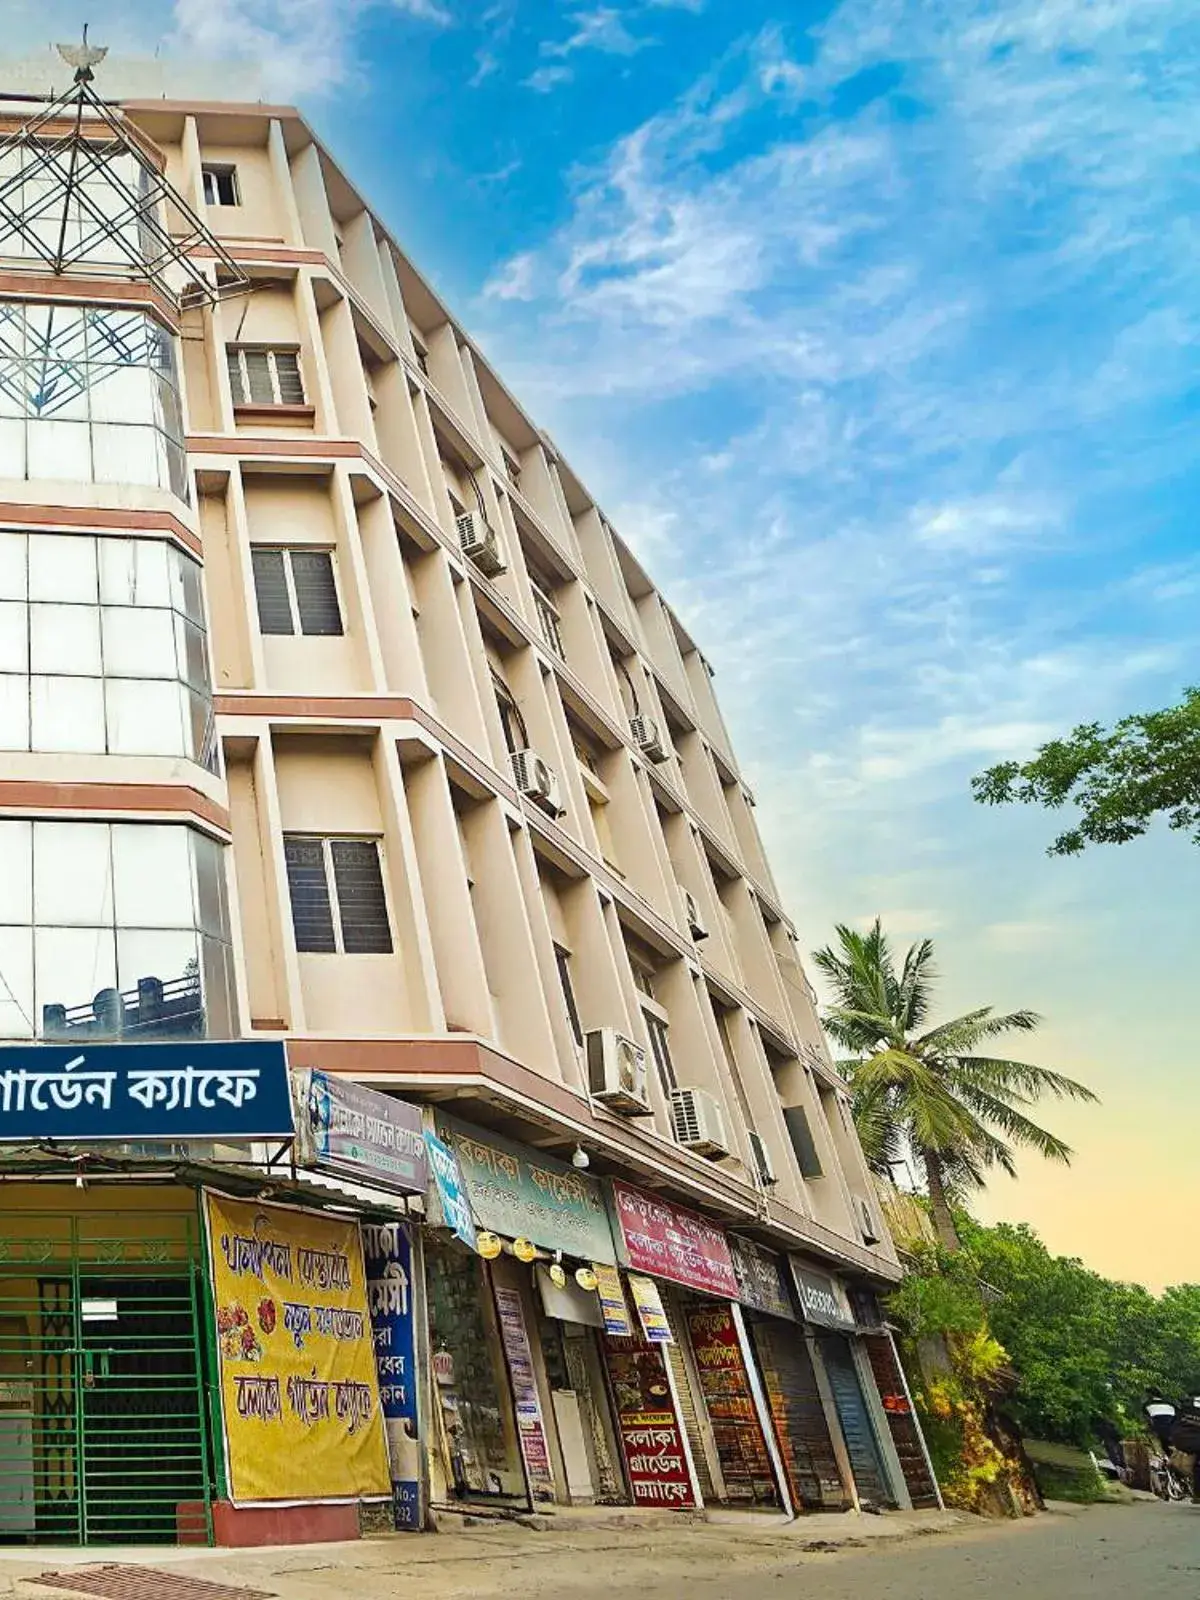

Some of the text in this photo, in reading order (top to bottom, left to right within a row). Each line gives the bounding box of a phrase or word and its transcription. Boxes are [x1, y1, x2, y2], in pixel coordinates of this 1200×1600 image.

[127, 1066, 261, 1110] ক্যাফে
[622, 1427, 678, 1448] বলাকা
[630, 1447, 683, 1474] গার্ডেন
